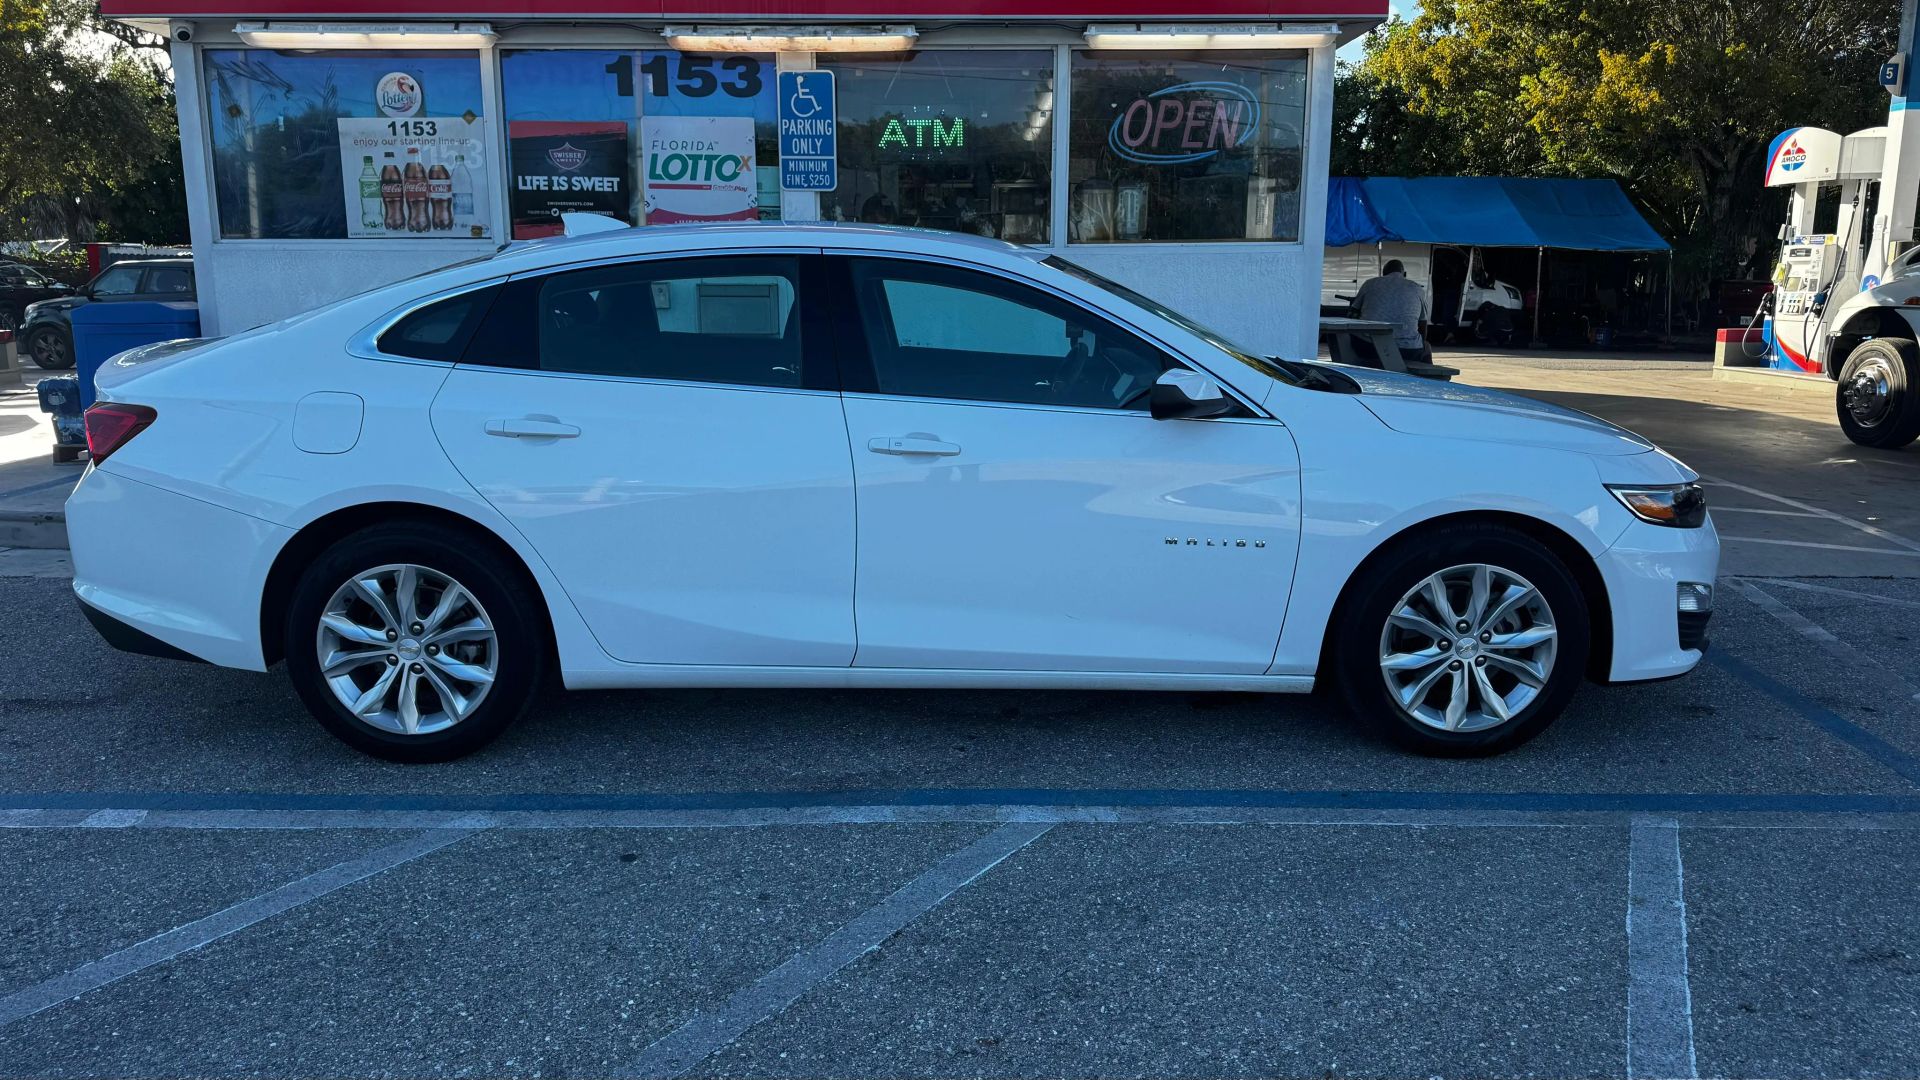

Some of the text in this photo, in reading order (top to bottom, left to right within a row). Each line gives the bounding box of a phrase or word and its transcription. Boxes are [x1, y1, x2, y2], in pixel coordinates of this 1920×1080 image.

[605, 55, 763, 97] 1153
[1885, 67, 1894, 79] 5
[387, 121, 438, 137] 1153
[782, 119, 832, 136] PARKING
[1121, 99, 1244, 149] OPEN
[877, 116, 965, 149] ATM
[353, 137, 378, 147] enjoy
[400, 137, 436, 147] starting
[652, 140, 714, 151] FLORIDA
[792, 138, 822, 155] ONLY
[788, 160, 828, 172] MINIMUM
[1781, 154, 1807, 164] AMOCO
[518, 175, 620, 192] LIFE IS SWEET
[786, 174, 830, 187] FINE $250
[1165, 536, 1266, 548] MALIBU
